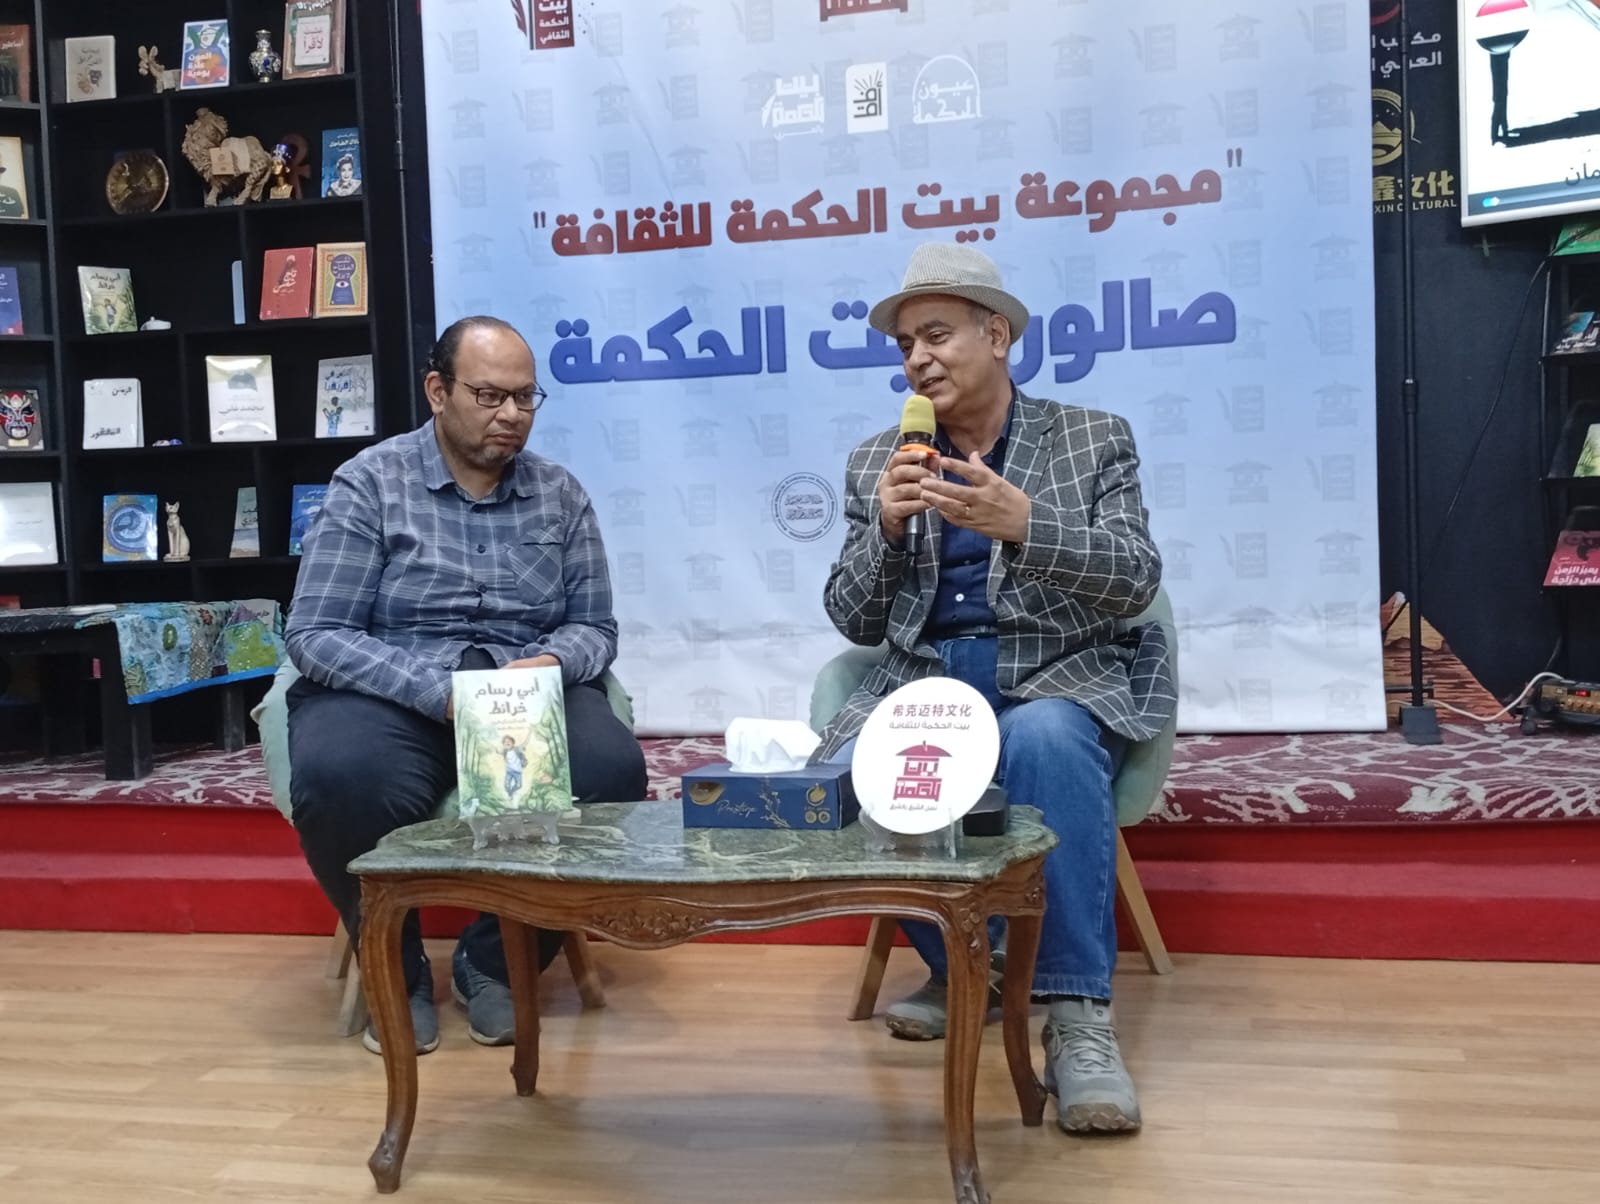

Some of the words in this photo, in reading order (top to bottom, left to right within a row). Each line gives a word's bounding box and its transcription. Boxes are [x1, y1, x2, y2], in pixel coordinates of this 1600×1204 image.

[539, 16, 569, 28] الحكمة
[540, 30, 570, 45] الثقافي
[1380, 31, 1441, 51] مكب
[1380, 51, 1442, 78] العري
[918, 79, 974, 100] عيون
[901, 182, 1000, 243] بيت
[1396, 199, 1457, 211] CLTURAL
[726, 187, 887, 243] الحكمة
[549, 305, 788, 385] الحكمة
[475, 682, 513, 699] رسام
[517, 676, 540, 700] أبي
[488, 700, 527, 716] خرائط
[892, 703, 973, 718] 希克迈特文化
[889, 720, 920, 730] للثقافة
[921, 720, 952, 730] الحكمة
[953, 721, 970, 731] بيت
